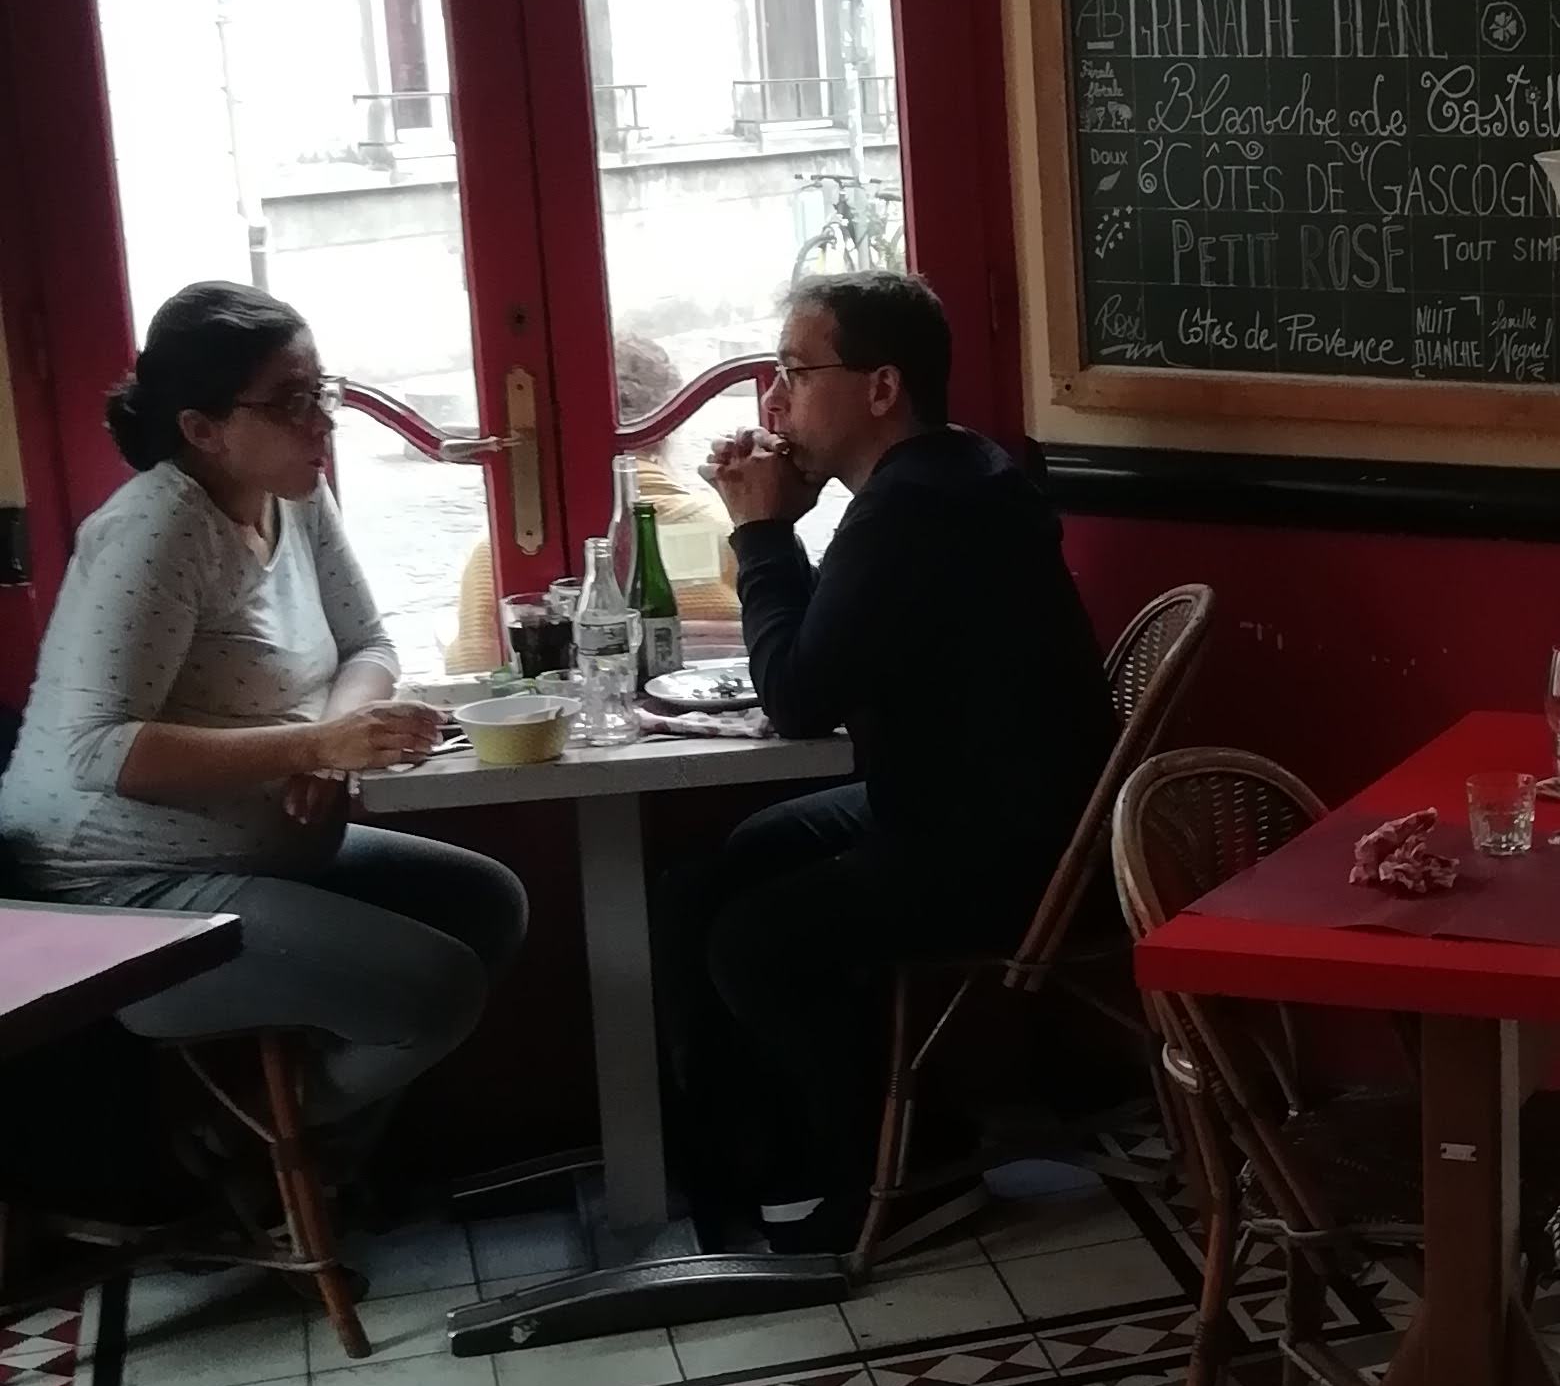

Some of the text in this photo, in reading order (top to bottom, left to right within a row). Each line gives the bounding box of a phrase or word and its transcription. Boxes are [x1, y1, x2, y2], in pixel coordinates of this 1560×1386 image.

[1147, 62, 1338, 137] Blanche
[1348, 73, 1408, 137] de
[1090, 147, 1129, 166] DOUX
[1163, 141, 1285, 212] CÔTES
[1306, 162, 1346, 213] DE
[1170, 218, 1280, 289] PETIT
[1300, 215, 1408, 294] ROSÉ
[1431, 232, 1497, 272] TOUT
[1243, 310, 1278, 351] de
[1277, 312, 1405, 367] Provence
[1416, 299, 1456, 335] NUIT
[1414, 337, 1483, 369] BLANCHE
